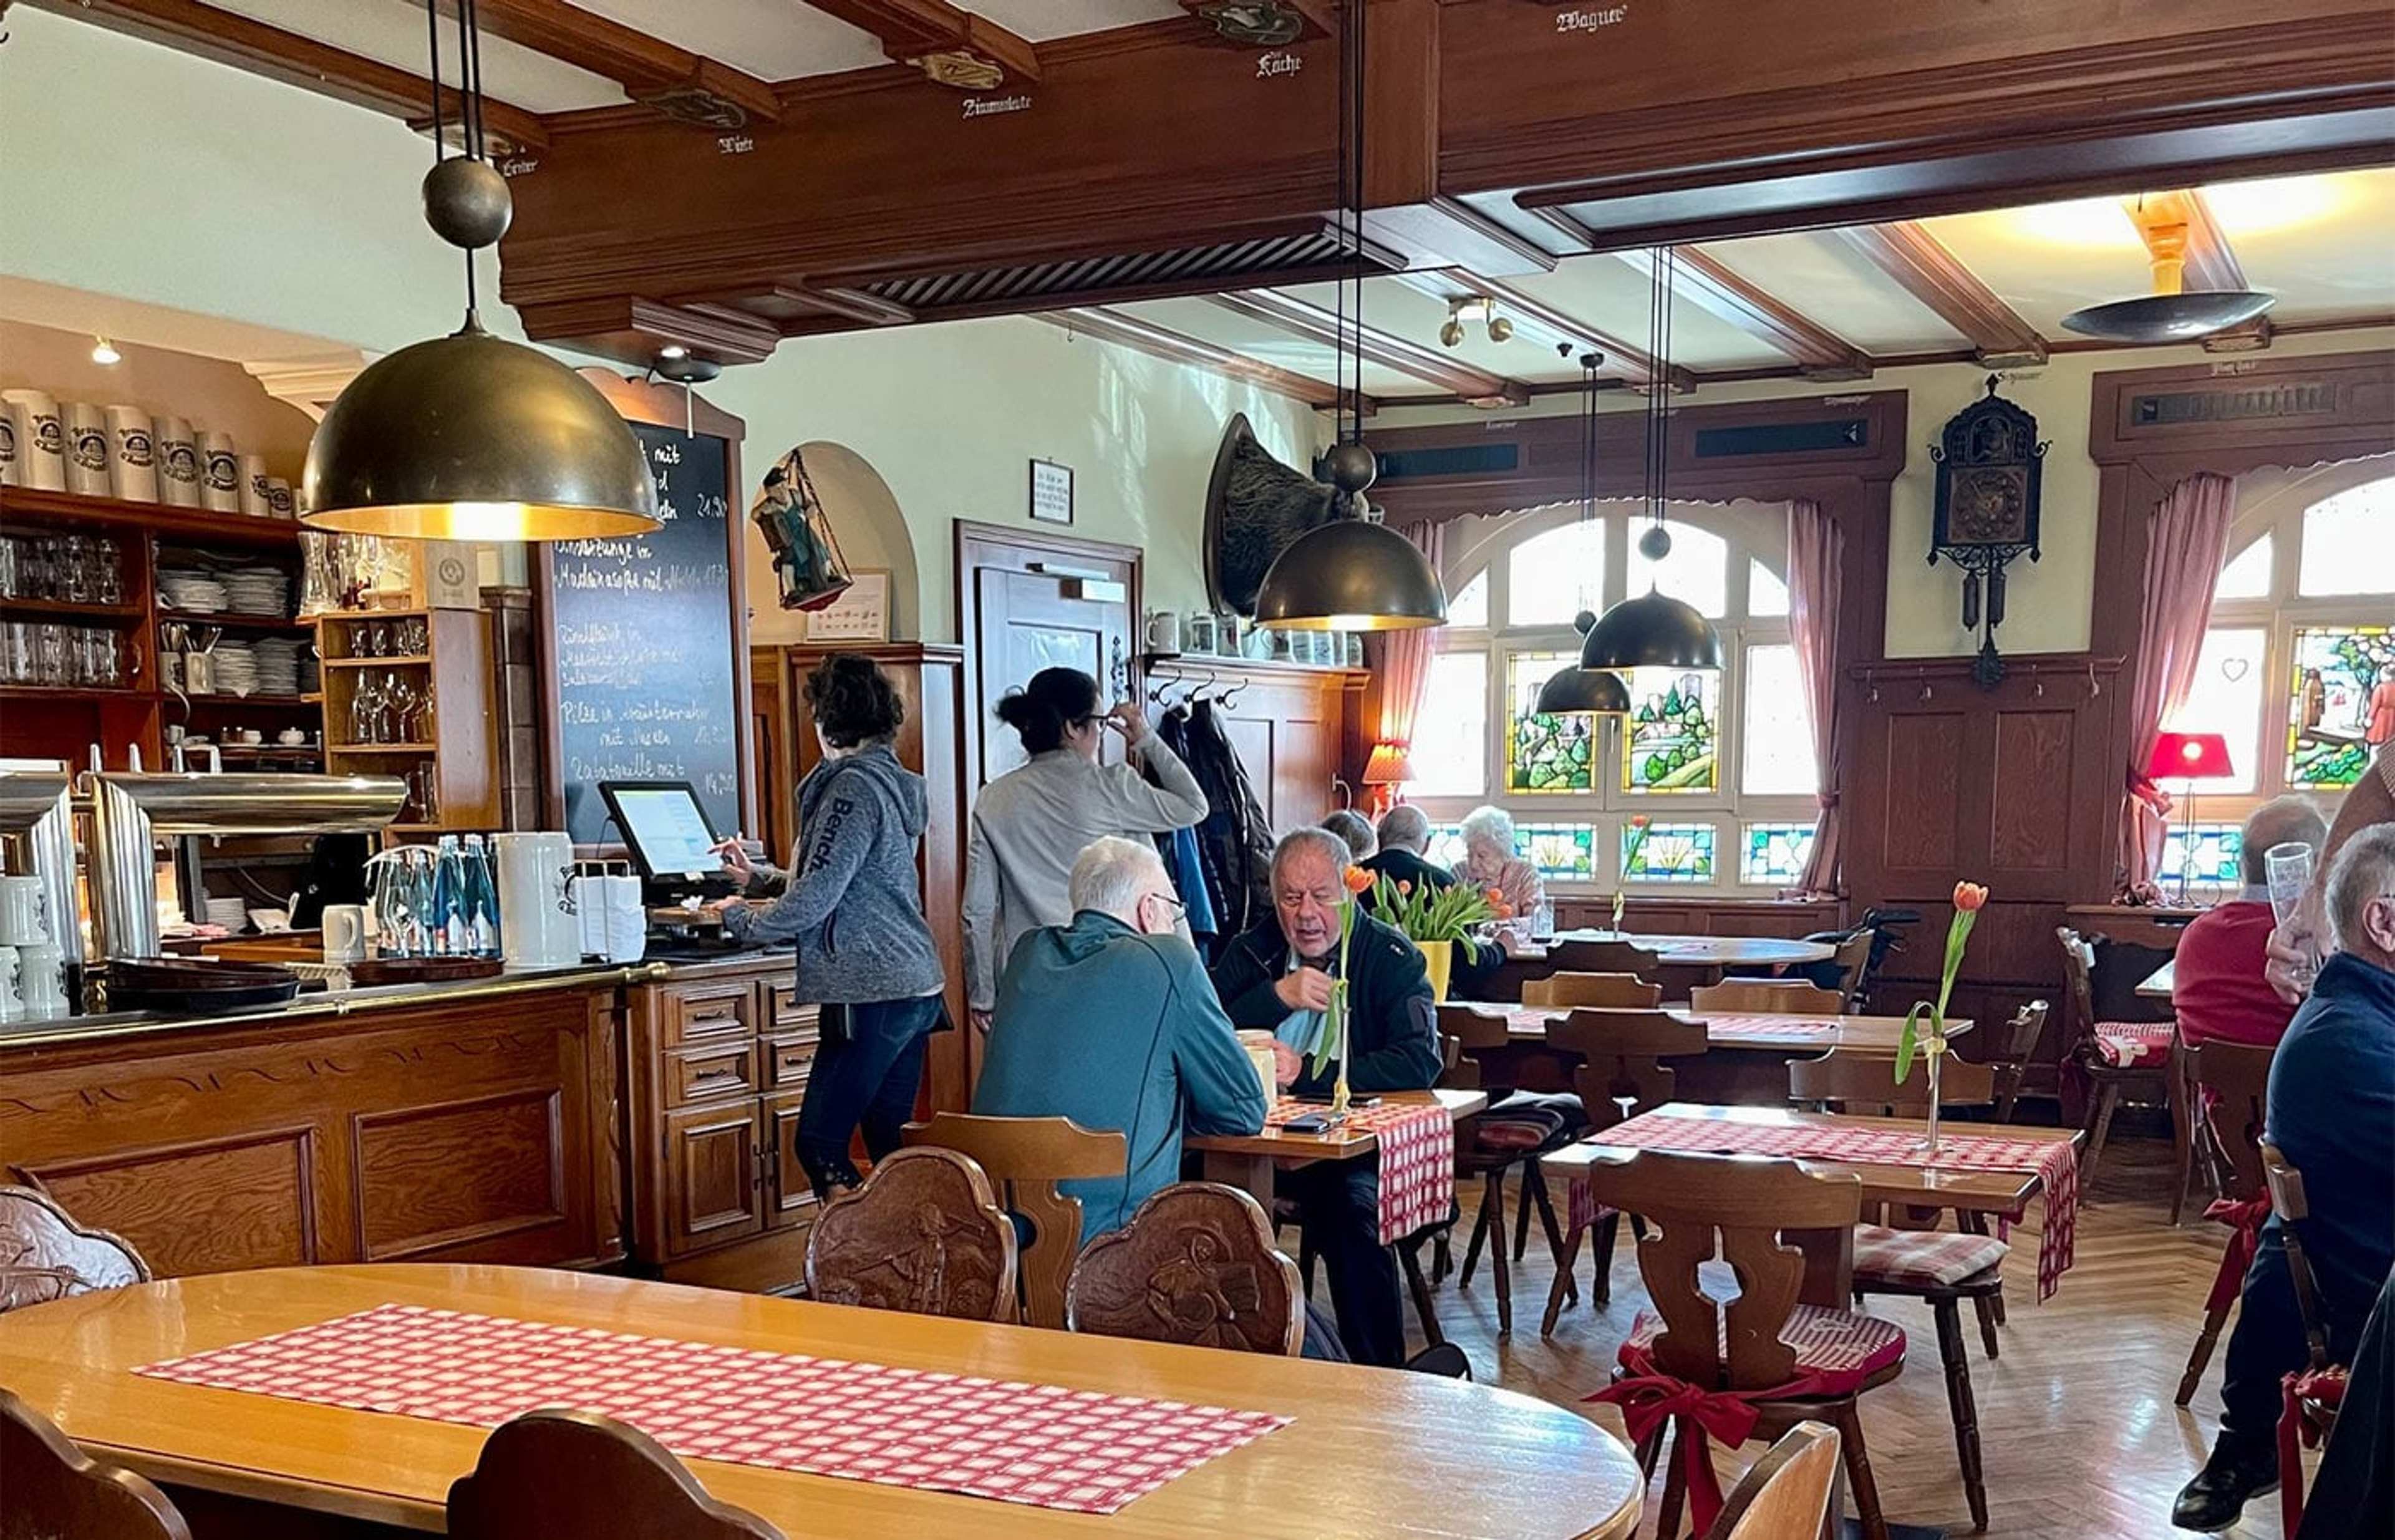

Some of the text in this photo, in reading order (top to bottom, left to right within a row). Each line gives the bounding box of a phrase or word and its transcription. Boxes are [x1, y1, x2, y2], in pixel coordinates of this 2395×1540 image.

[1556, 5, 1627, 32] Wagner
[654, 443, 680, 464] mit
[808, 797, 854, 873] Bench
